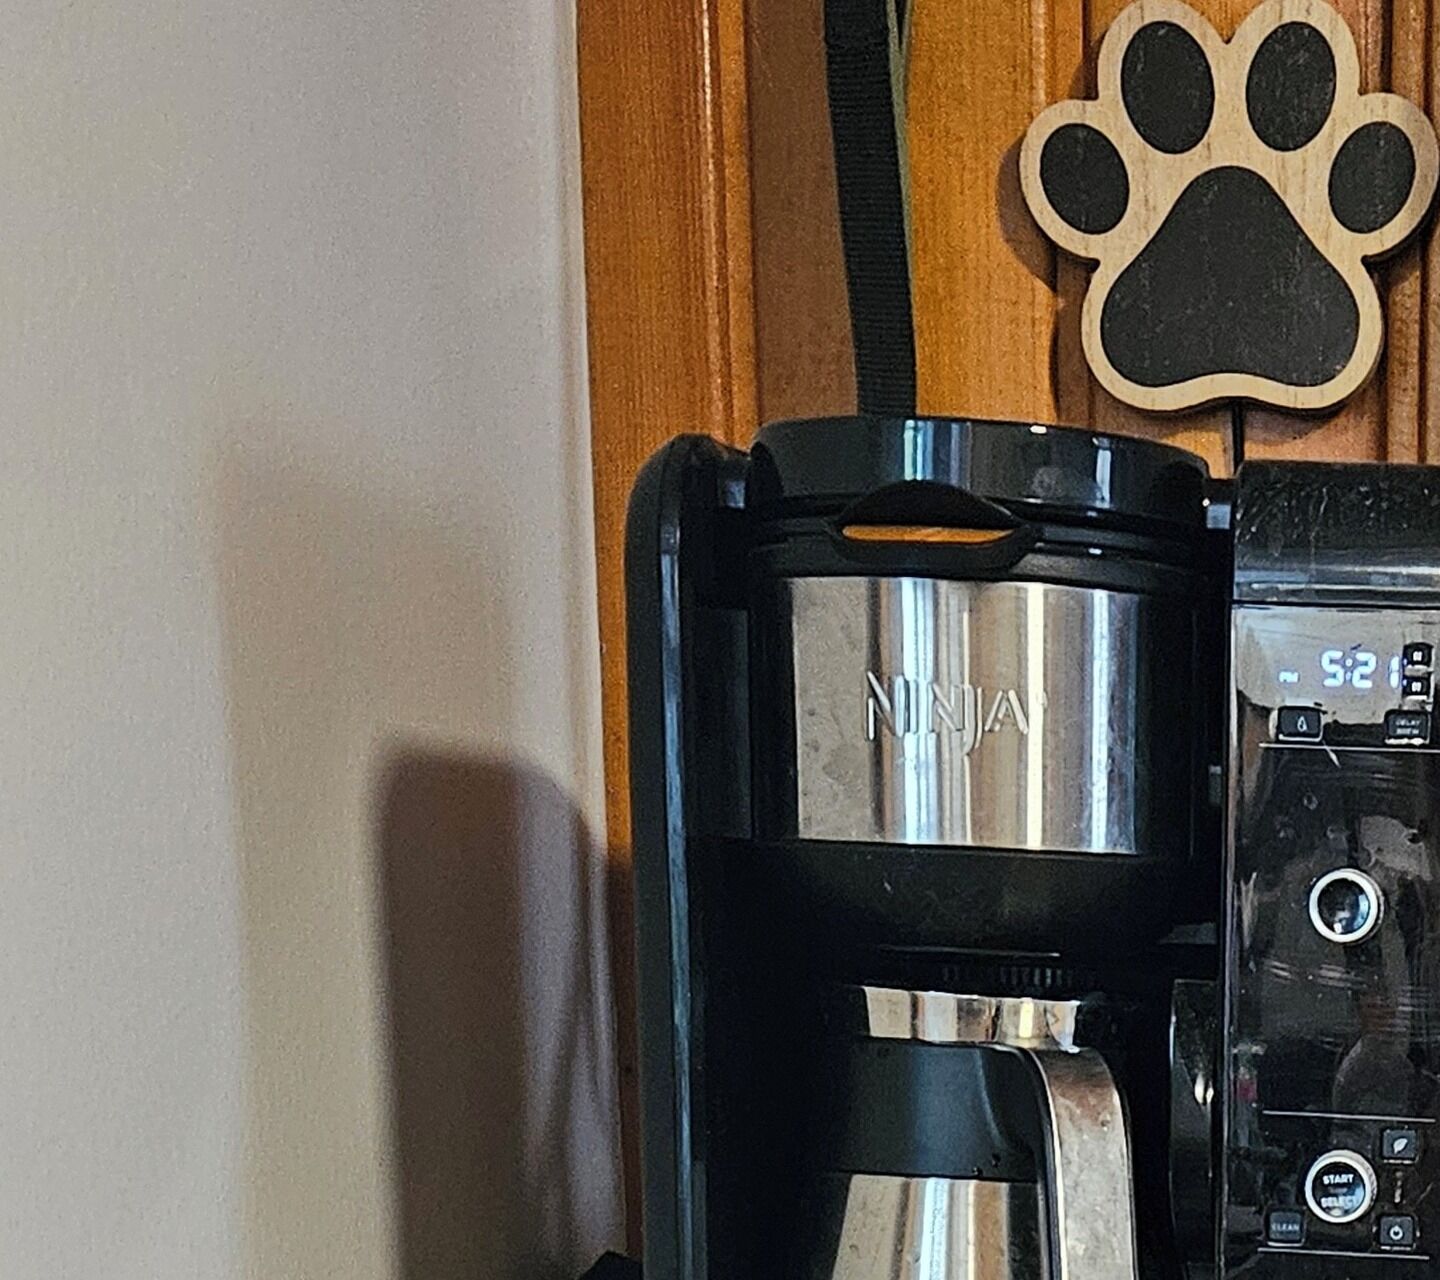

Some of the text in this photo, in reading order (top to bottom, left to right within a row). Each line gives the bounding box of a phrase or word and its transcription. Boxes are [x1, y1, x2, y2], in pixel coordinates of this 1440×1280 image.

[1321, 650, 1400, 689] 5:21
[867, 671, 1029, 755] NINJA
[1322, 1174, 1354, 1185] START
[1271, 1222, 1300, 1232] CLEAN
